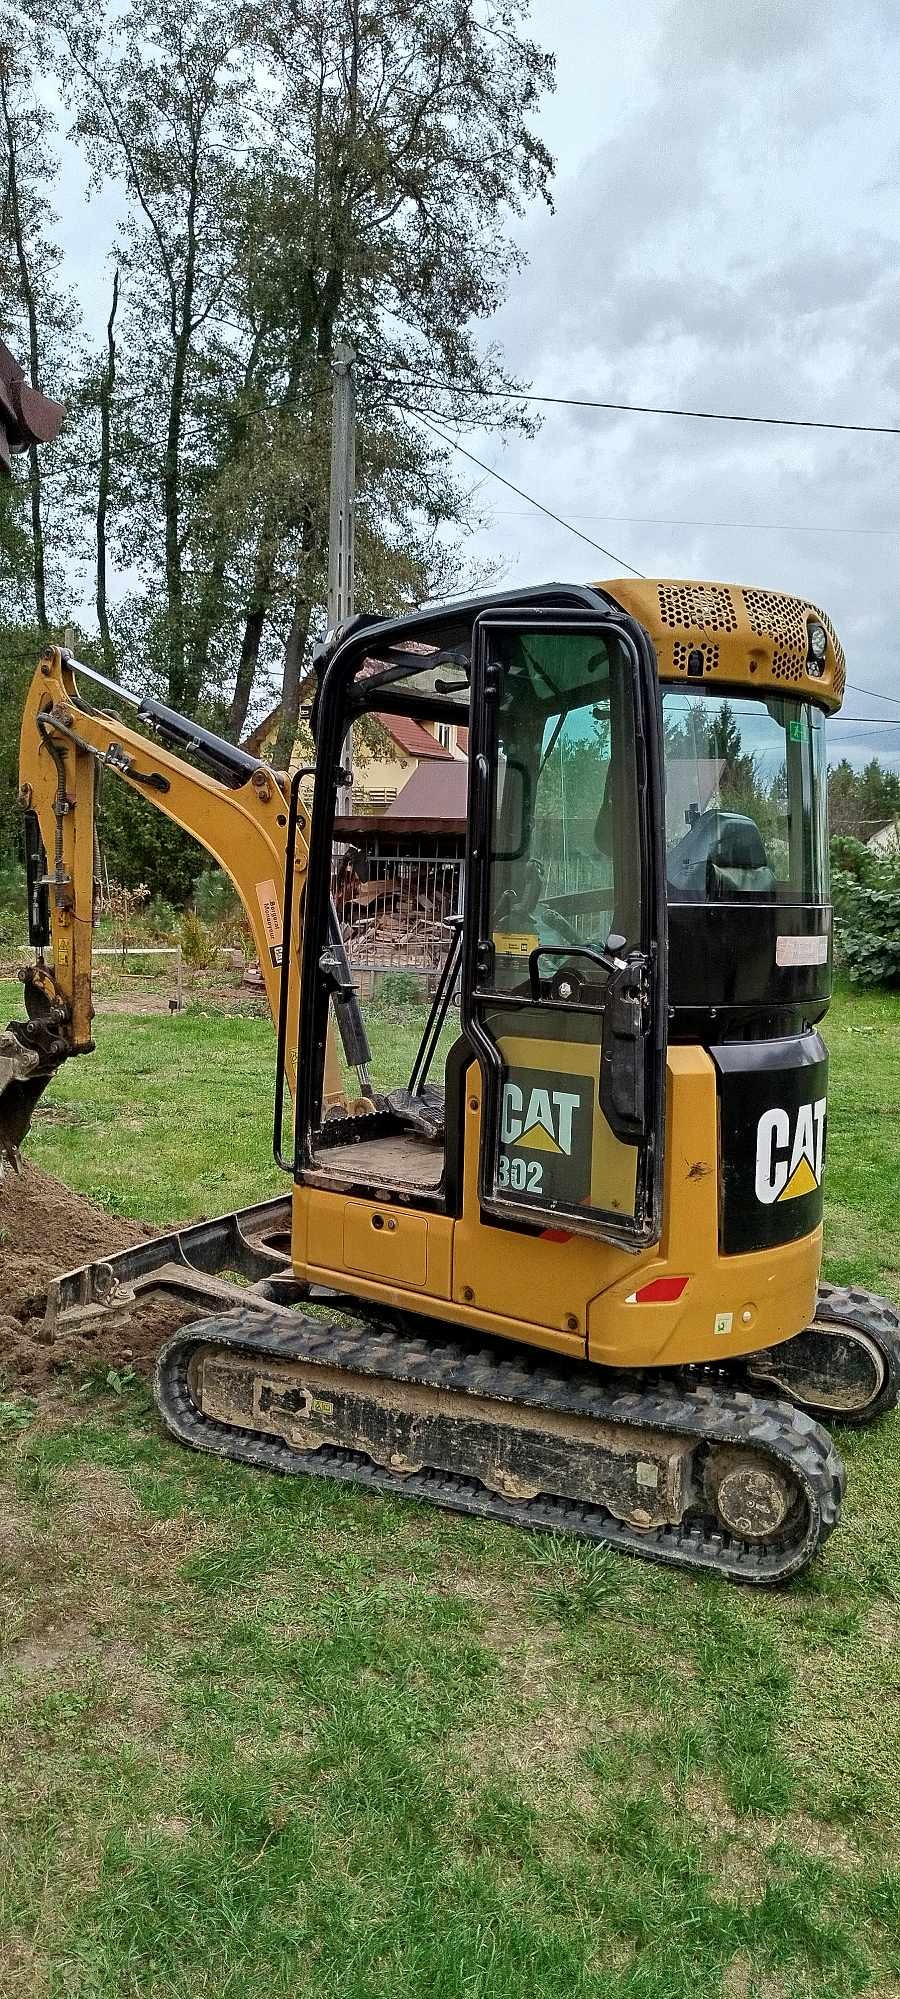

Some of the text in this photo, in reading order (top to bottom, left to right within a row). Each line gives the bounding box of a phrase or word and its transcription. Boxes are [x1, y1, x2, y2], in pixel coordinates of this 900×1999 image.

[501, 1083, 580, 1155] CAT
[755, 1097, 826, 1203] CAT
[498, 1155, 543, 1194] 302
